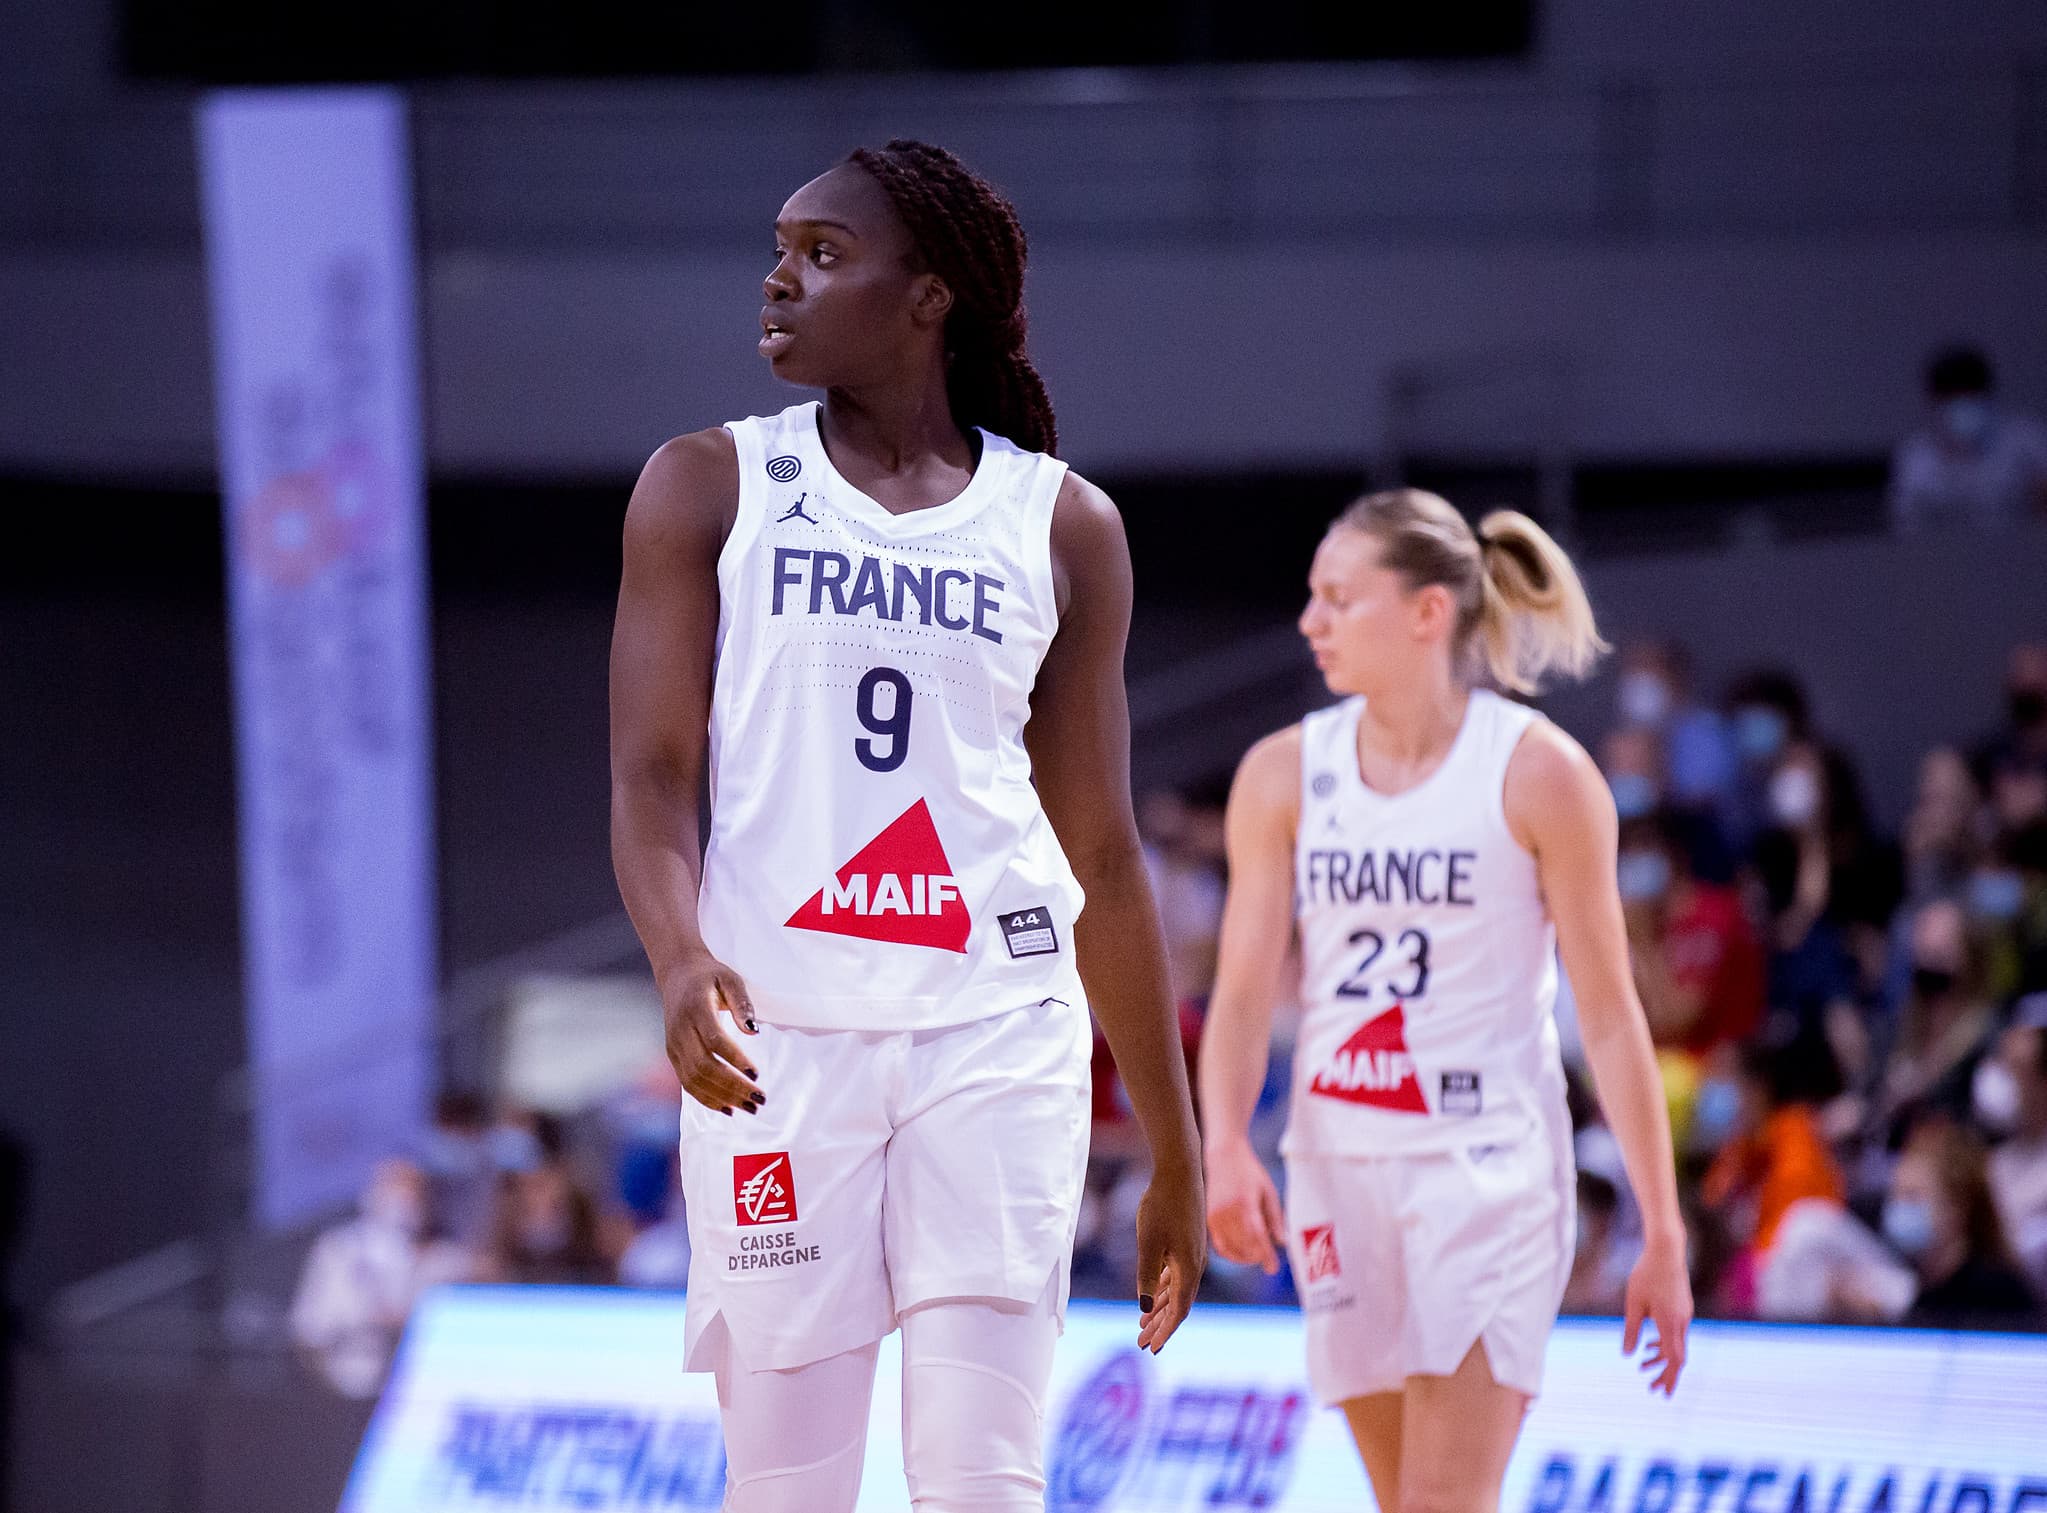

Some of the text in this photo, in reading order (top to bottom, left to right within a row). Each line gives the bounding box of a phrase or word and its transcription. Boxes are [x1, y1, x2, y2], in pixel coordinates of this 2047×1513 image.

[771, 547, 1005, 645] FRANCE
[854, 666, 913, 773] 9
[821, 873, 958, 916] MAIF
[1308, 850, 1477, 906] FRANCE
[1011, 913, 1041, 928] 44
[1336, 928, 1429, 998] 23
[1318, 1050, 1415, 1091] MAIF
[728, 1245, 822, 1271] D'EPARGNE
[740, 1231, 797, 1252] CAISSE
